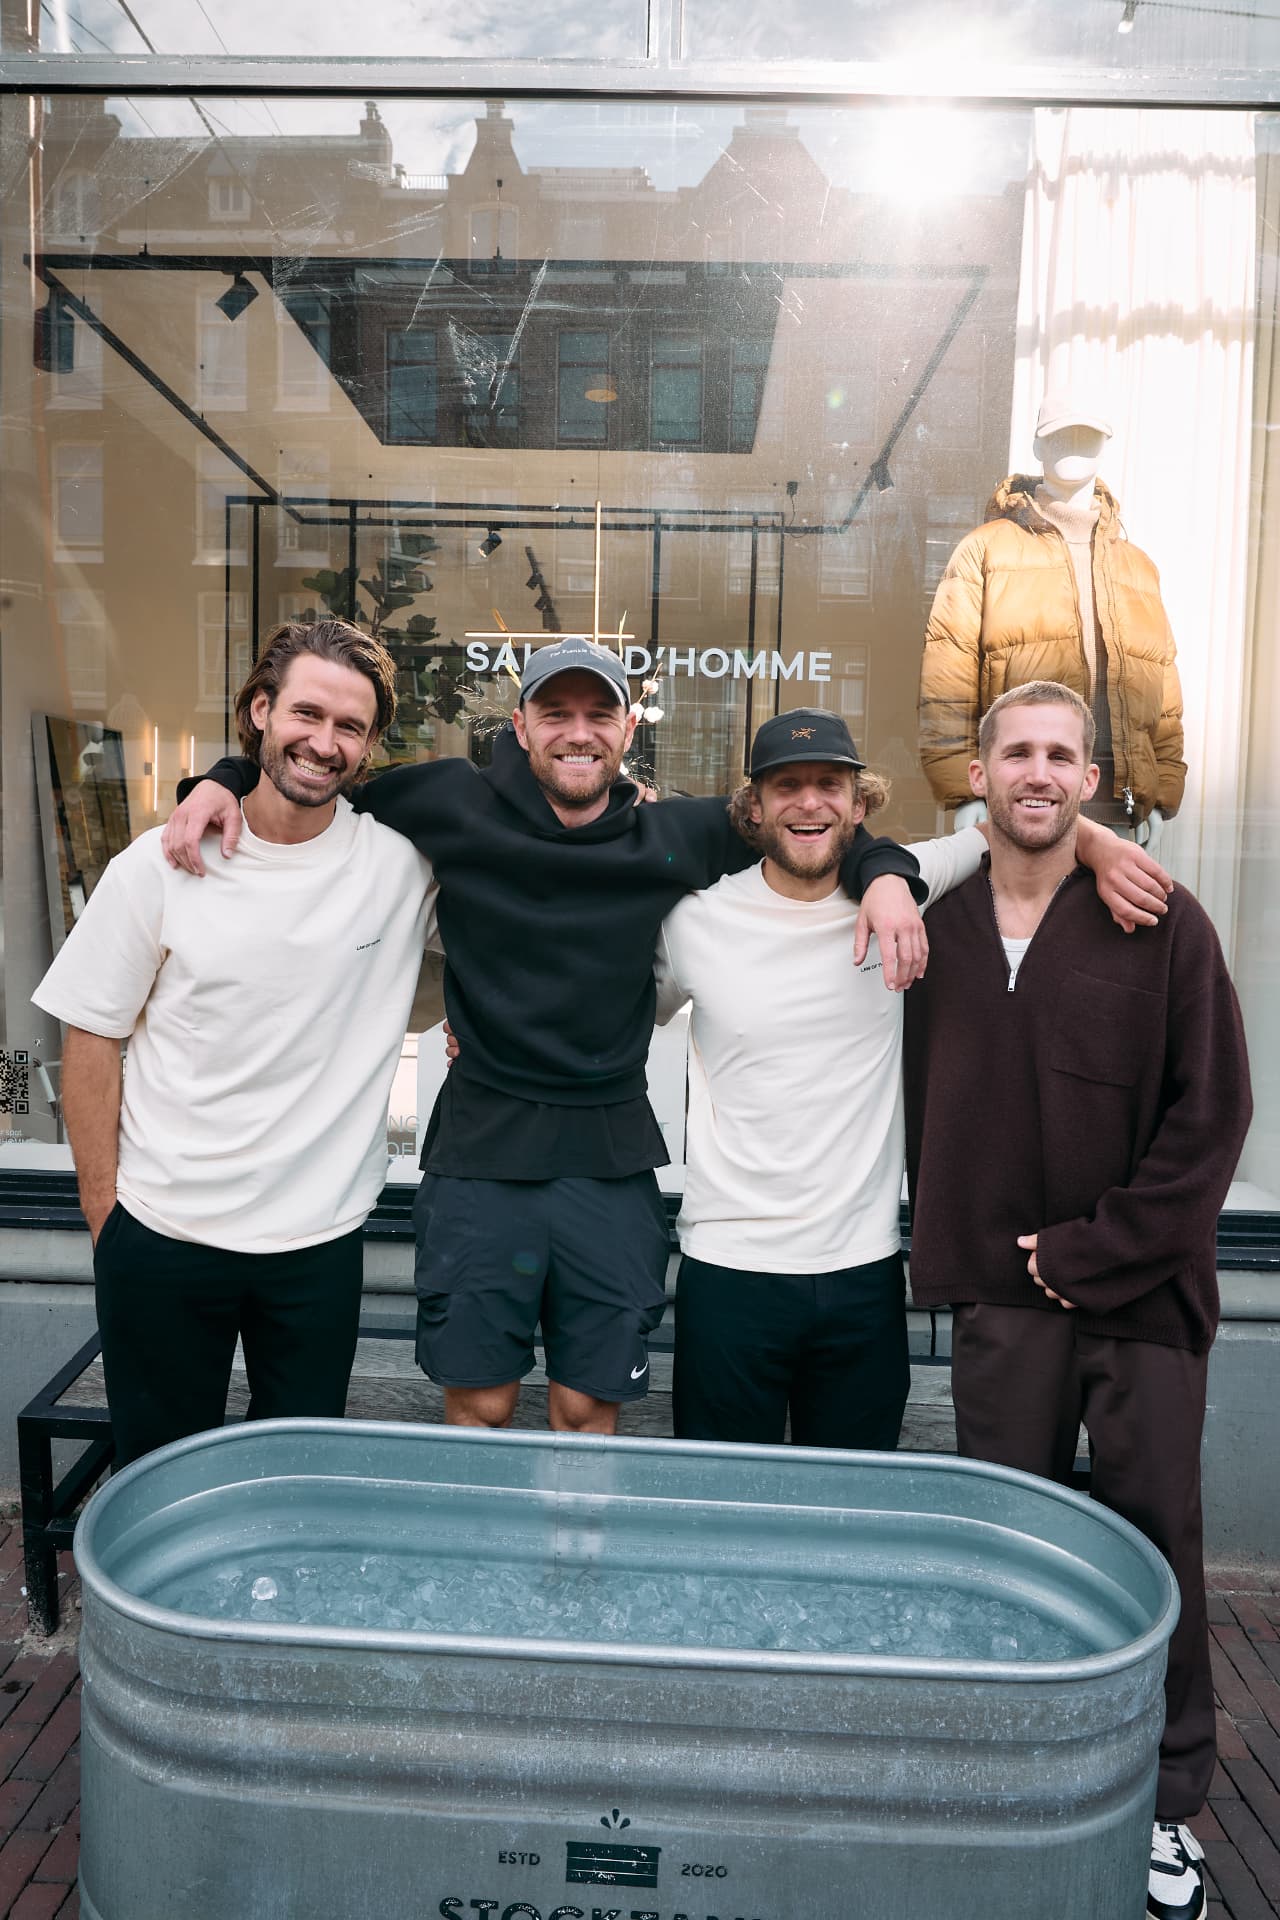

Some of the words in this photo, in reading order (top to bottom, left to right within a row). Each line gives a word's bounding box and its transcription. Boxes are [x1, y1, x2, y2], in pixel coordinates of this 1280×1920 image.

[625, 646, 832, 682] D'HOMME
[498, 1851, 541, 1866] ESTD
[681, 1863, 728, 1878] 2020
